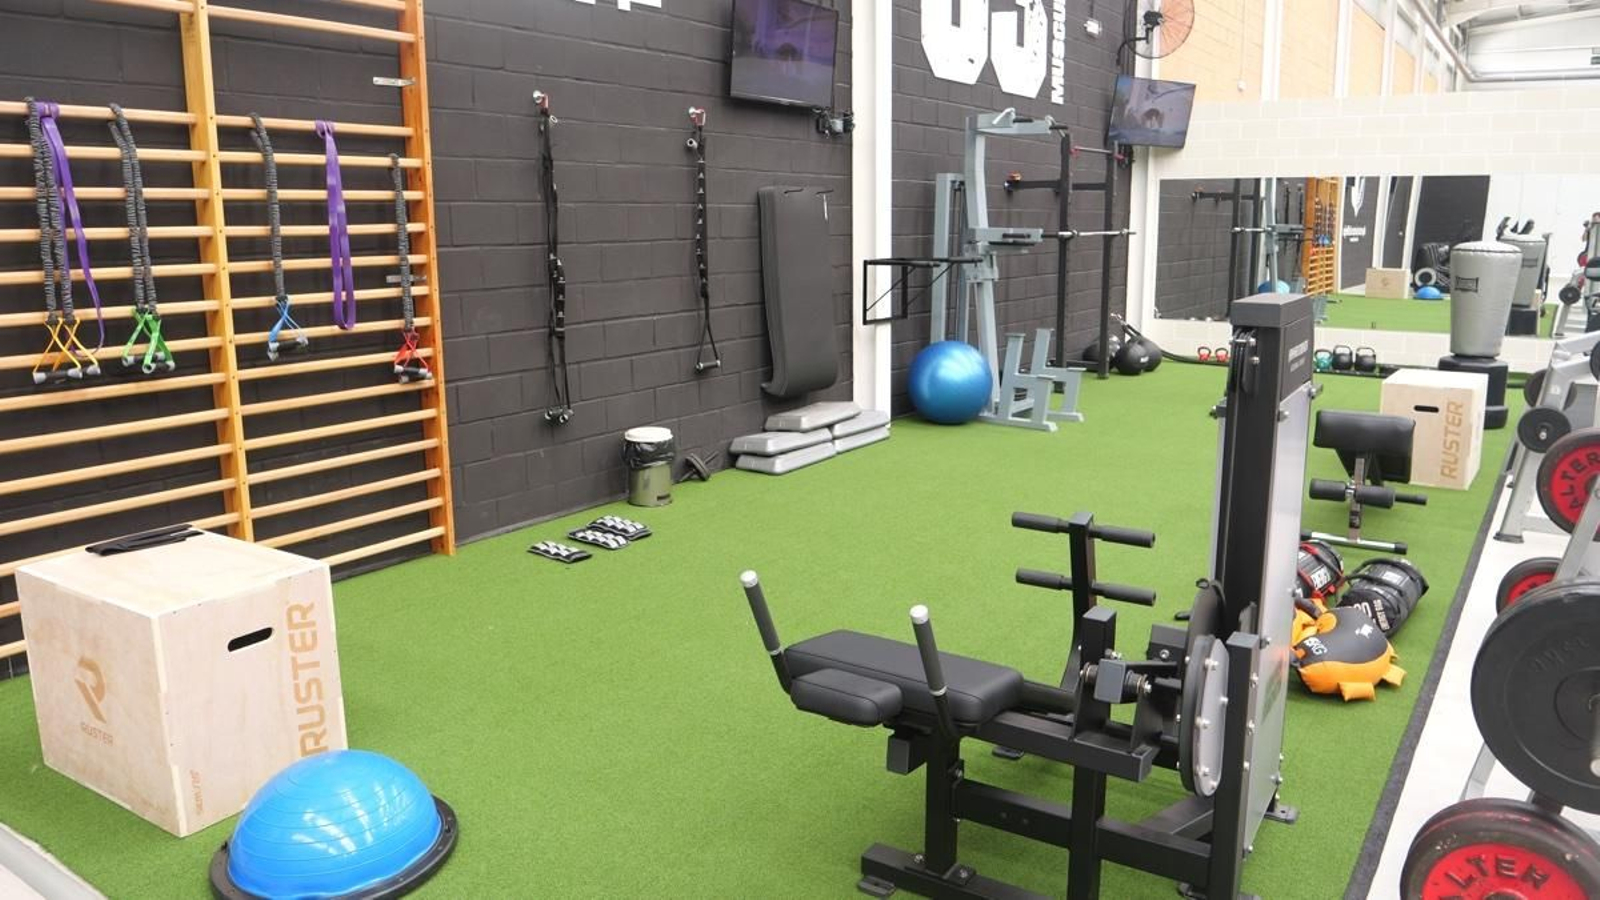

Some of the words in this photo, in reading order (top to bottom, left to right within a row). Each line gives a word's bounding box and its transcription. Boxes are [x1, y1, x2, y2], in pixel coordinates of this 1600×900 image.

[1440, 400, 1464, 480] RUSTER
[286, 602, 329, 758] RUSTER
[1438, 852, 1549, 900] LTER
